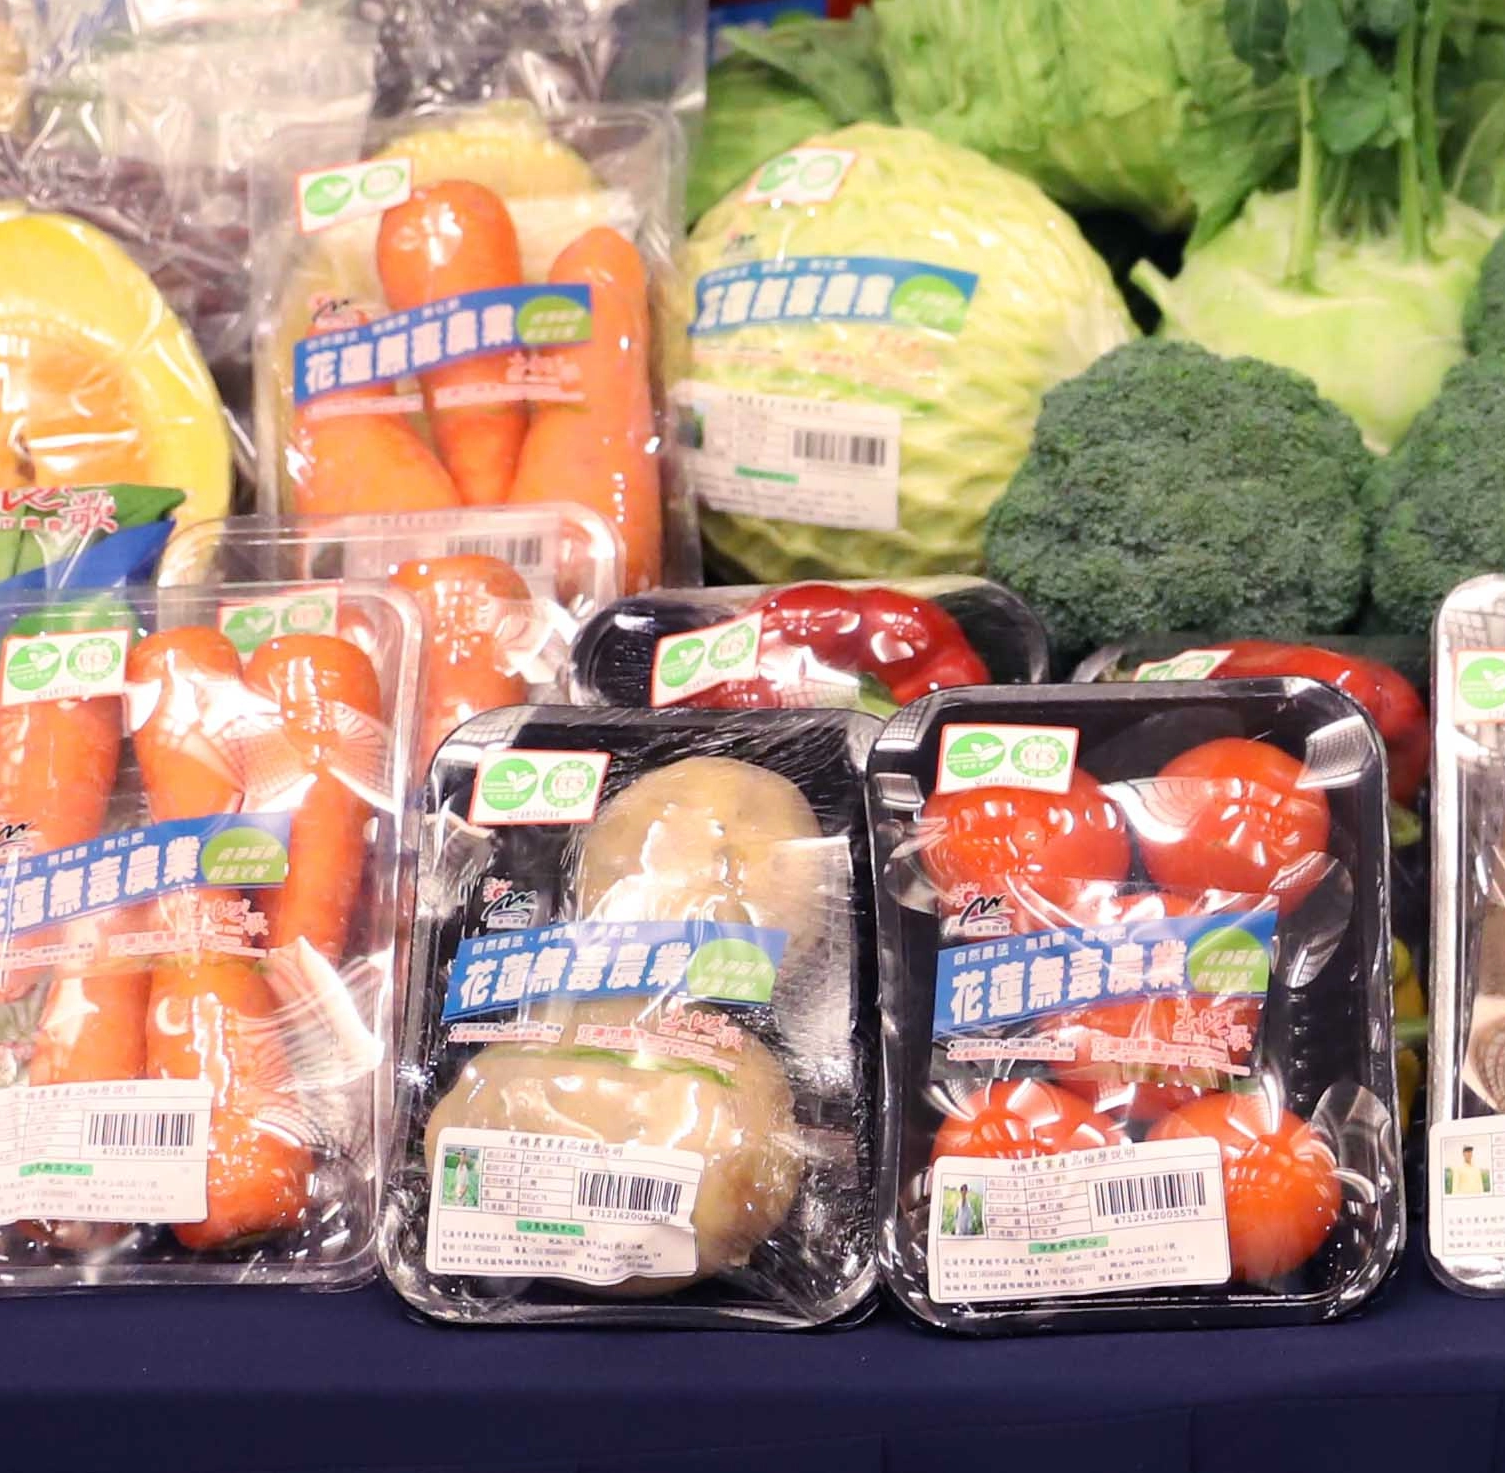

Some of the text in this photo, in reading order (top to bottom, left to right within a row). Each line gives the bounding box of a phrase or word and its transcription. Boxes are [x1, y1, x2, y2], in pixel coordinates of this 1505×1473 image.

[461, 943, 692, 1007] 花蓮無毒農業
[951, 939, 1188, 1024] 花蓮無毒農業
[1114, 1208, 1200, 1225] 4712162005576
